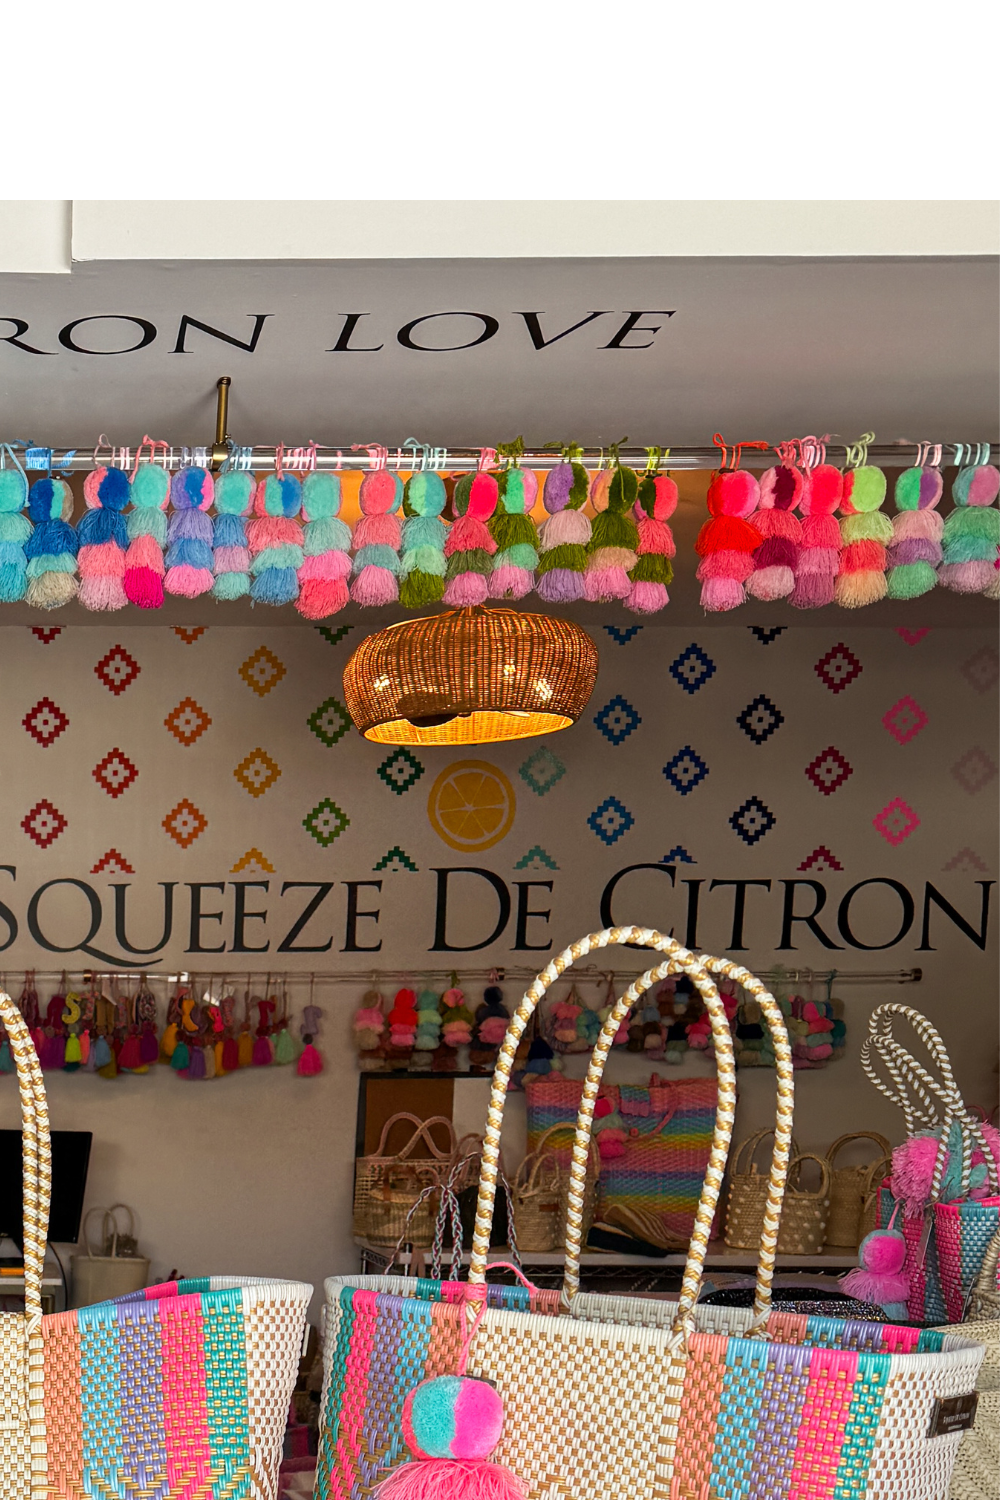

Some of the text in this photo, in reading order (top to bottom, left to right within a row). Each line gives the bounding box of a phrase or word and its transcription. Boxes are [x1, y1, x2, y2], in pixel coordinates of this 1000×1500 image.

[325, 310, 677, 352] LOVE
[427, 867, 554, 952] DE
[600, 863, 997, 951] CITRON
